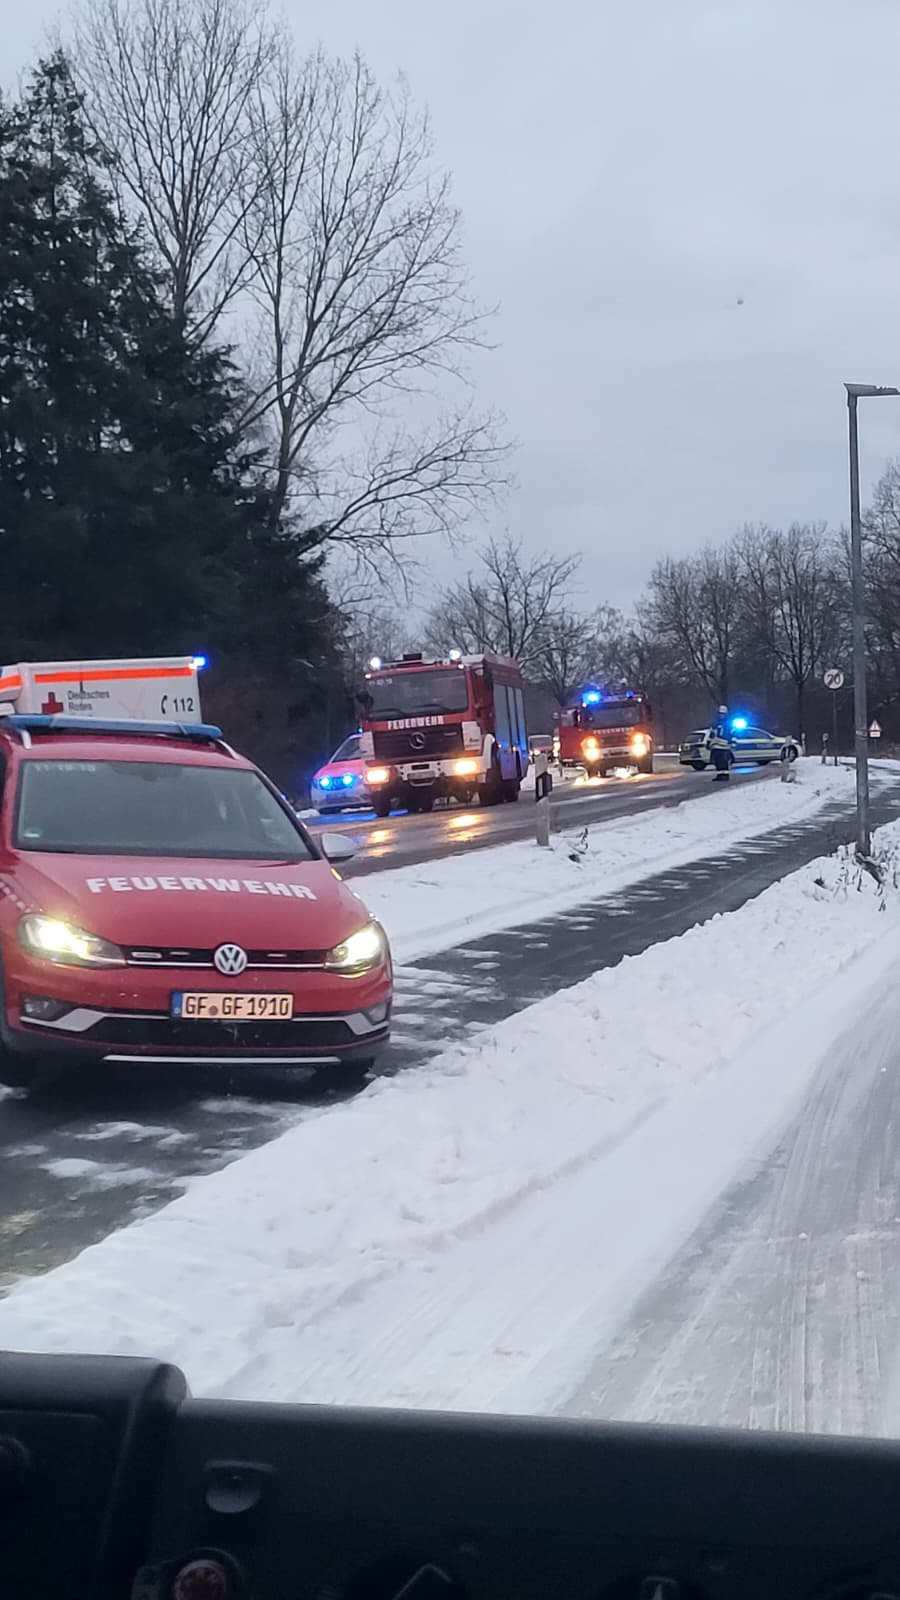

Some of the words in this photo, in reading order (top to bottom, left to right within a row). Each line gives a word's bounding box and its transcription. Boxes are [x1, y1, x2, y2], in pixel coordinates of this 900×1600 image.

[172, 697, 194, 712] 112
[387, 715, 444, 730] FEUERWEHR
[86, 876, 317, 900] FEUERWEHR
[185, 996, 208, 1015] GF
